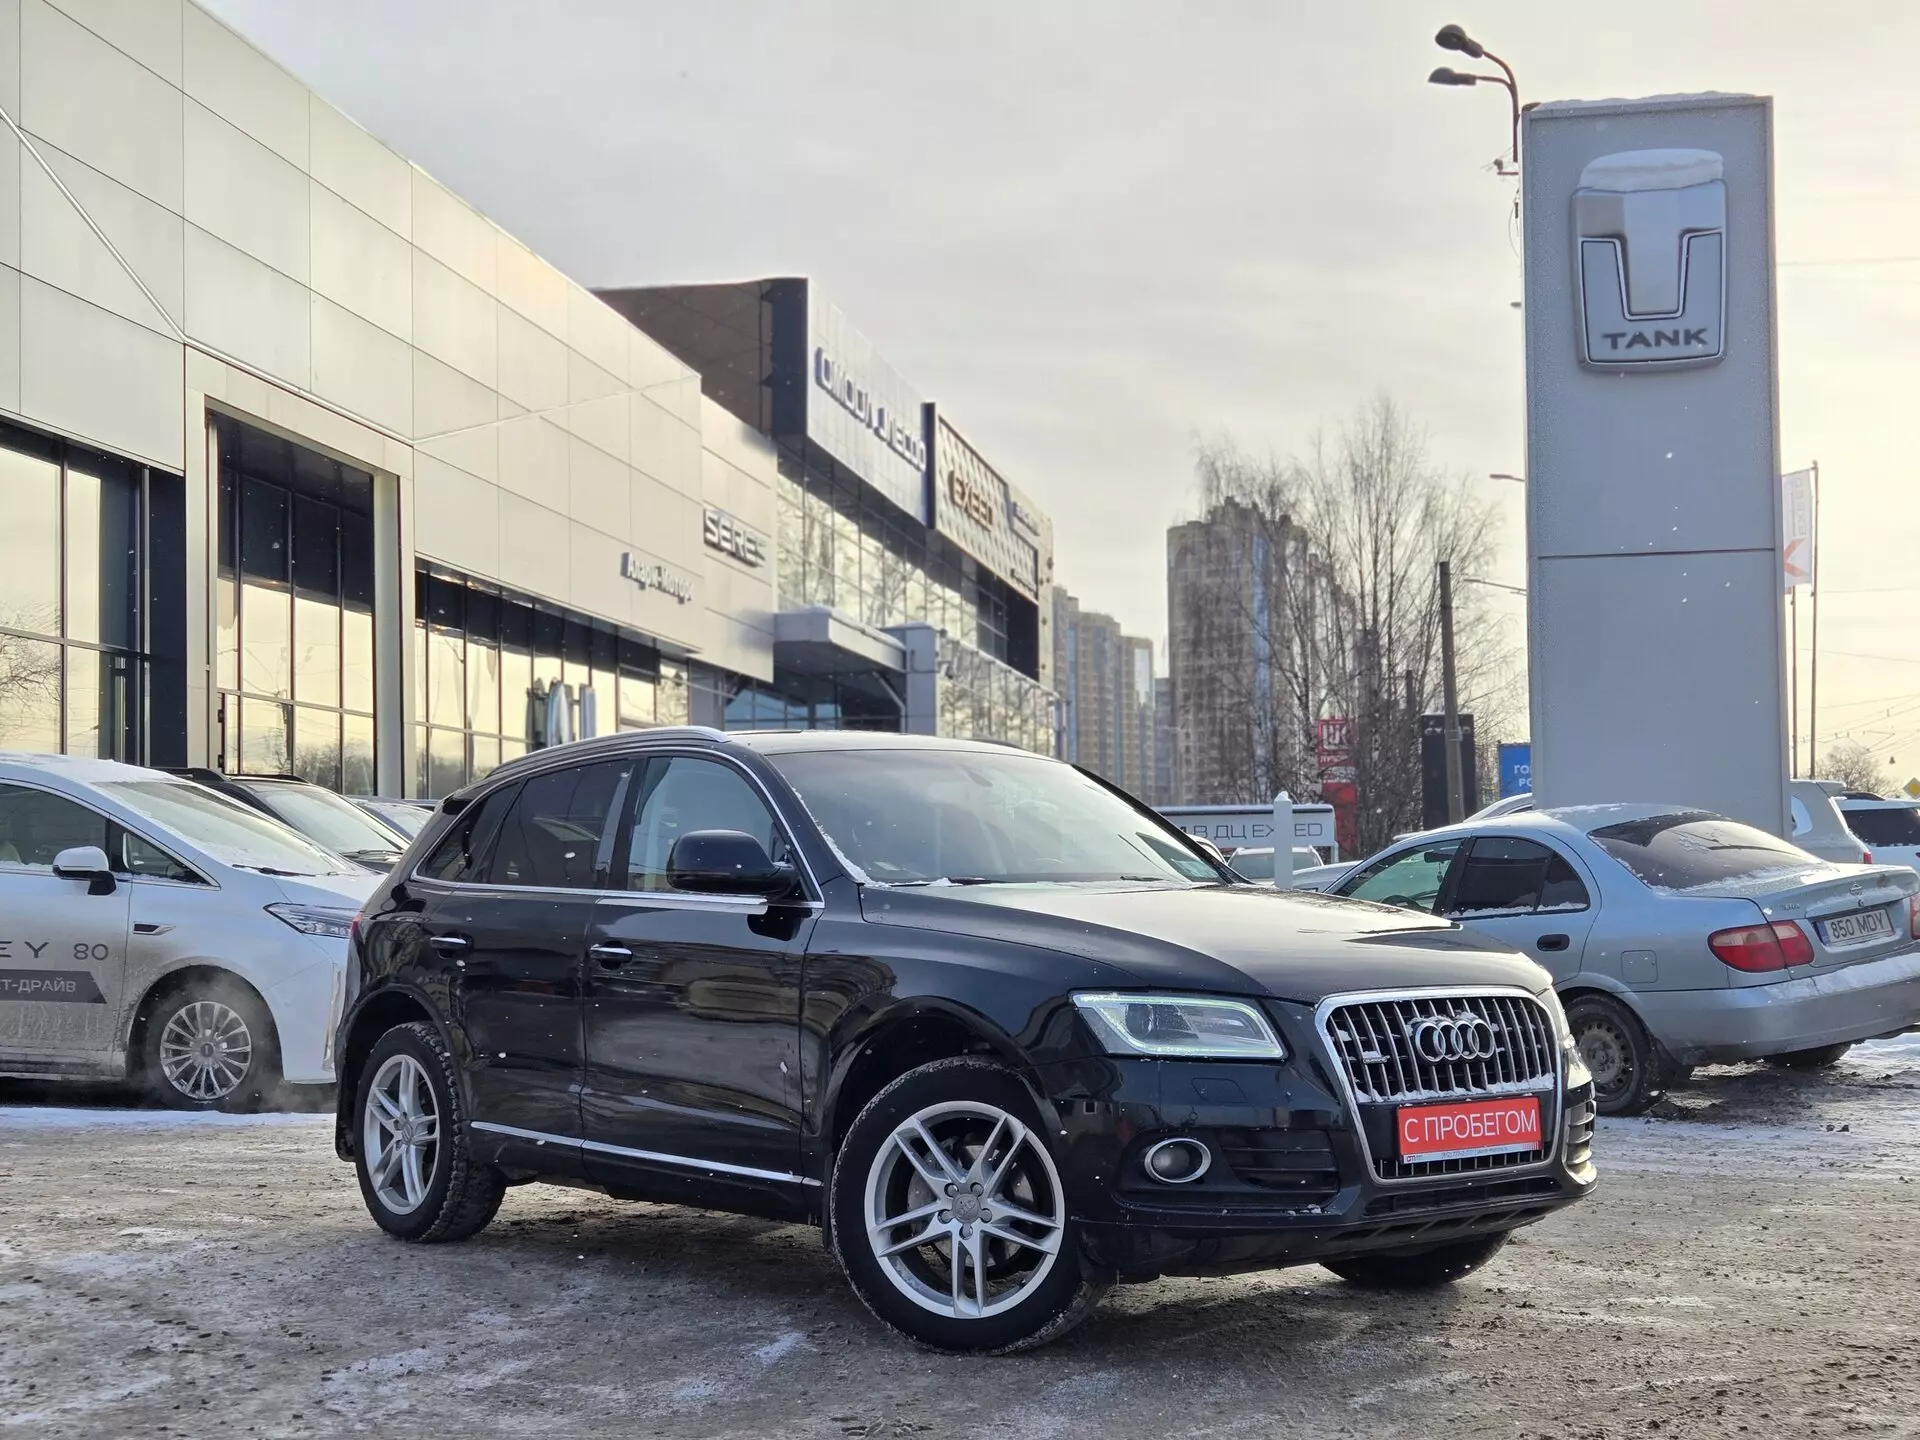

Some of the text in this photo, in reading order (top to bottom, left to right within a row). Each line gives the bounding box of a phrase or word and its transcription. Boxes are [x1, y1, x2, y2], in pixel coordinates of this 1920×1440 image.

[1602, 328, 1709, 351] TANK
[1213, 824, 1247, 840] ДЦ
[1252, 823, 1323, 838] EXED
[1830, 911, 1885, 939] 850 MDY
[0, 941, 109, 961] EY 80
[0, 977, 77, 993] Т-ДРАЙВ
[1404, 1109, 1537, 1142] С ПРОБЕГОМ
